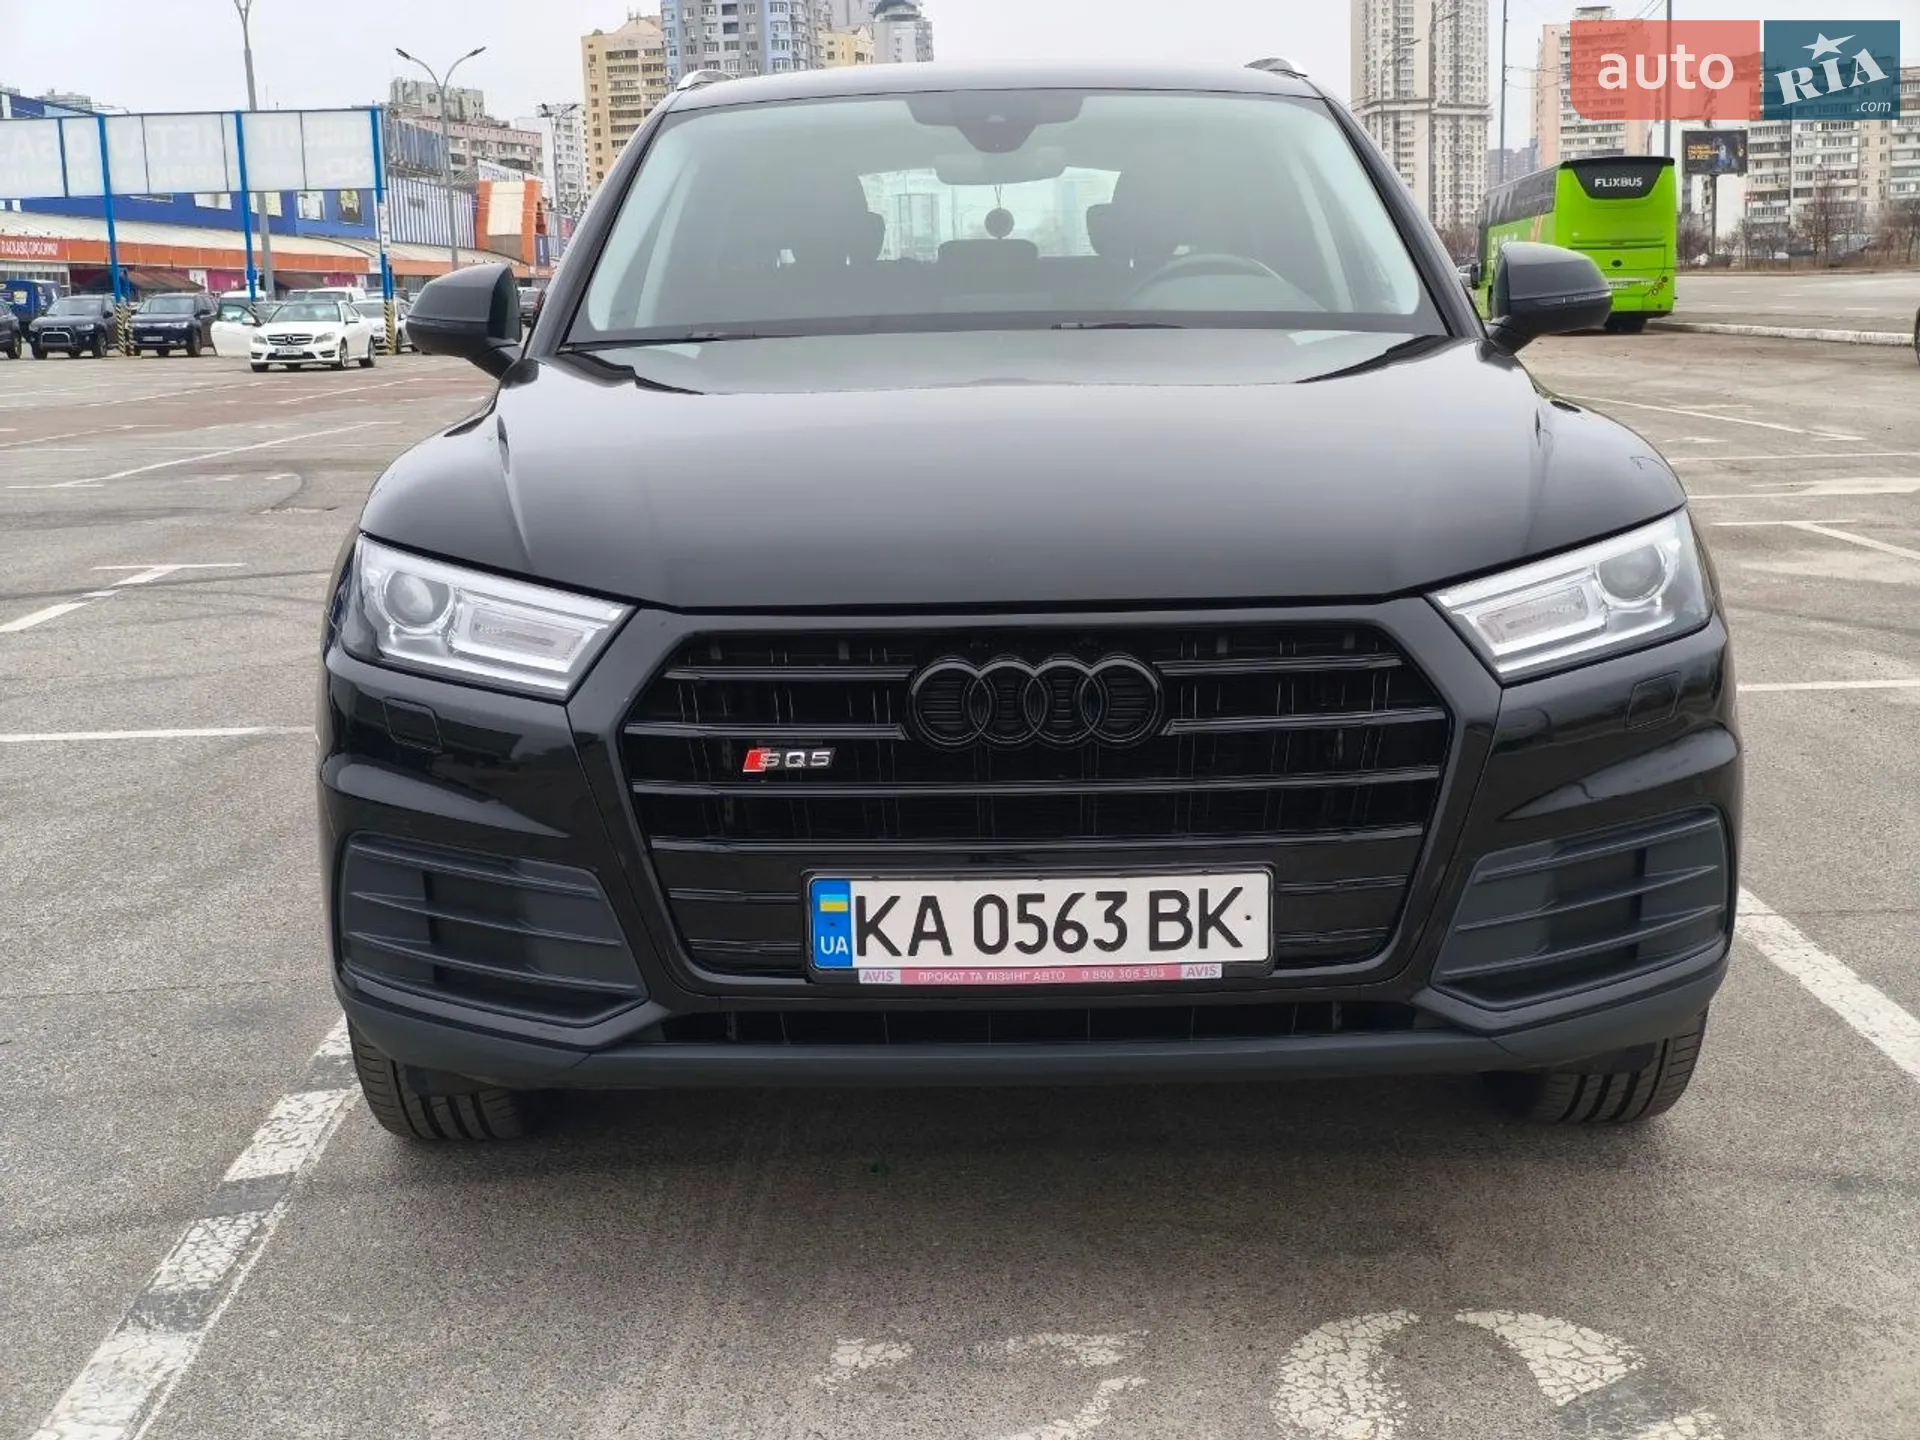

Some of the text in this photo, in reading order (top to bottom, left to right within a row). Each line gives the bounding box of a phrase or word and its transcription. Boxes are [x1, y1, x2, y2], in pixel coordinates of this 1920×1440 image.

[757, 751, 831, 768] SQ5
[855, 886, 1243, 957] KA 0563 BK
[820, 935, 849, 955] UA
[862, 971, 894, 982] AVIS
[918, 971, 965, 982] ПРОКАТ
[970, 971, 983, 981] ТА
[987, 971, 1030, 981] ЛІЗИНГ
[1033, 970, 1066, 981] АВТО
[1092, 969, 1114, 980] 800
[1186, 967, 1217, 977] AVIS
